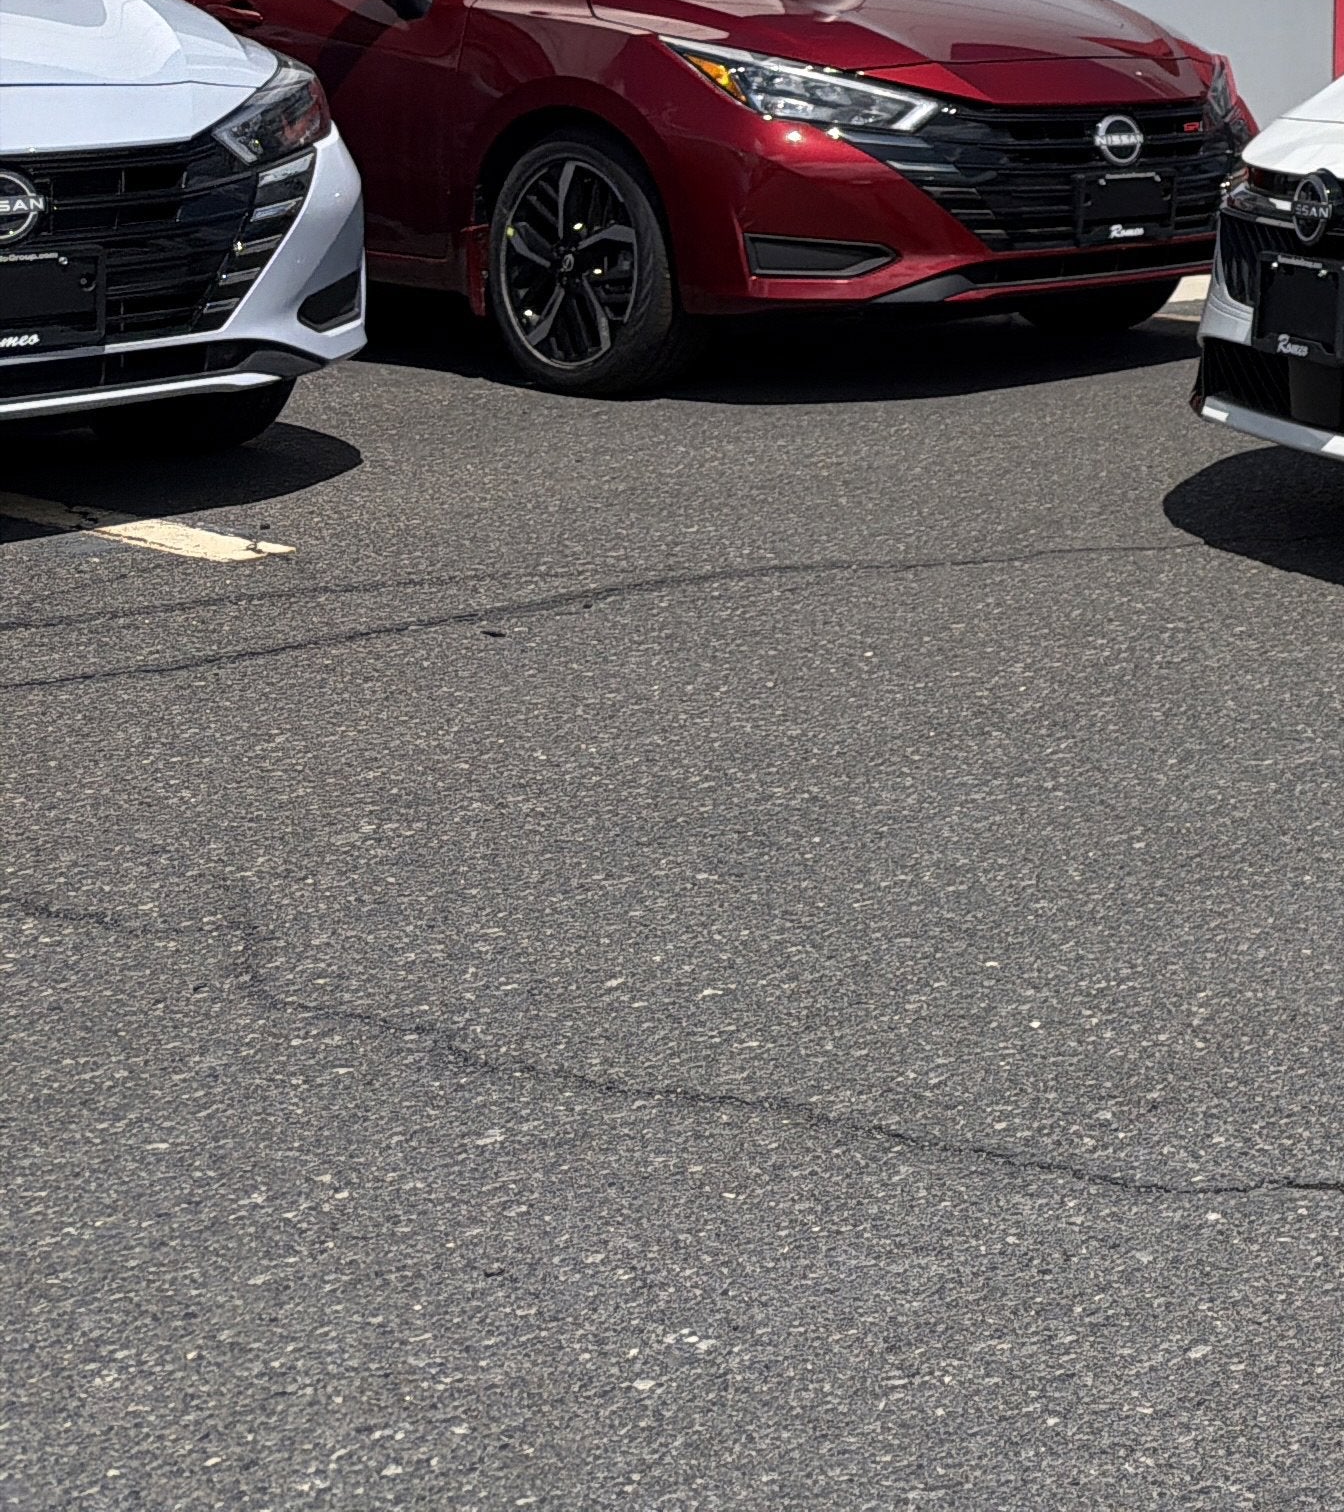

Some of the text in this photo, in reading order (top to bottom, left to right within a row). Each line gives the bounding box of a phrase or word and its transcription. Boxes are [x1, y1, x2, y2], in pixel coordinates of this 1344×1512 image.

[1095, 134, 1143, 146] NISSAN
[0, 197, 44, 211] SAN
[1295, 202, 1329, 218] SSAN
[0, 334, 40, 347] meo
